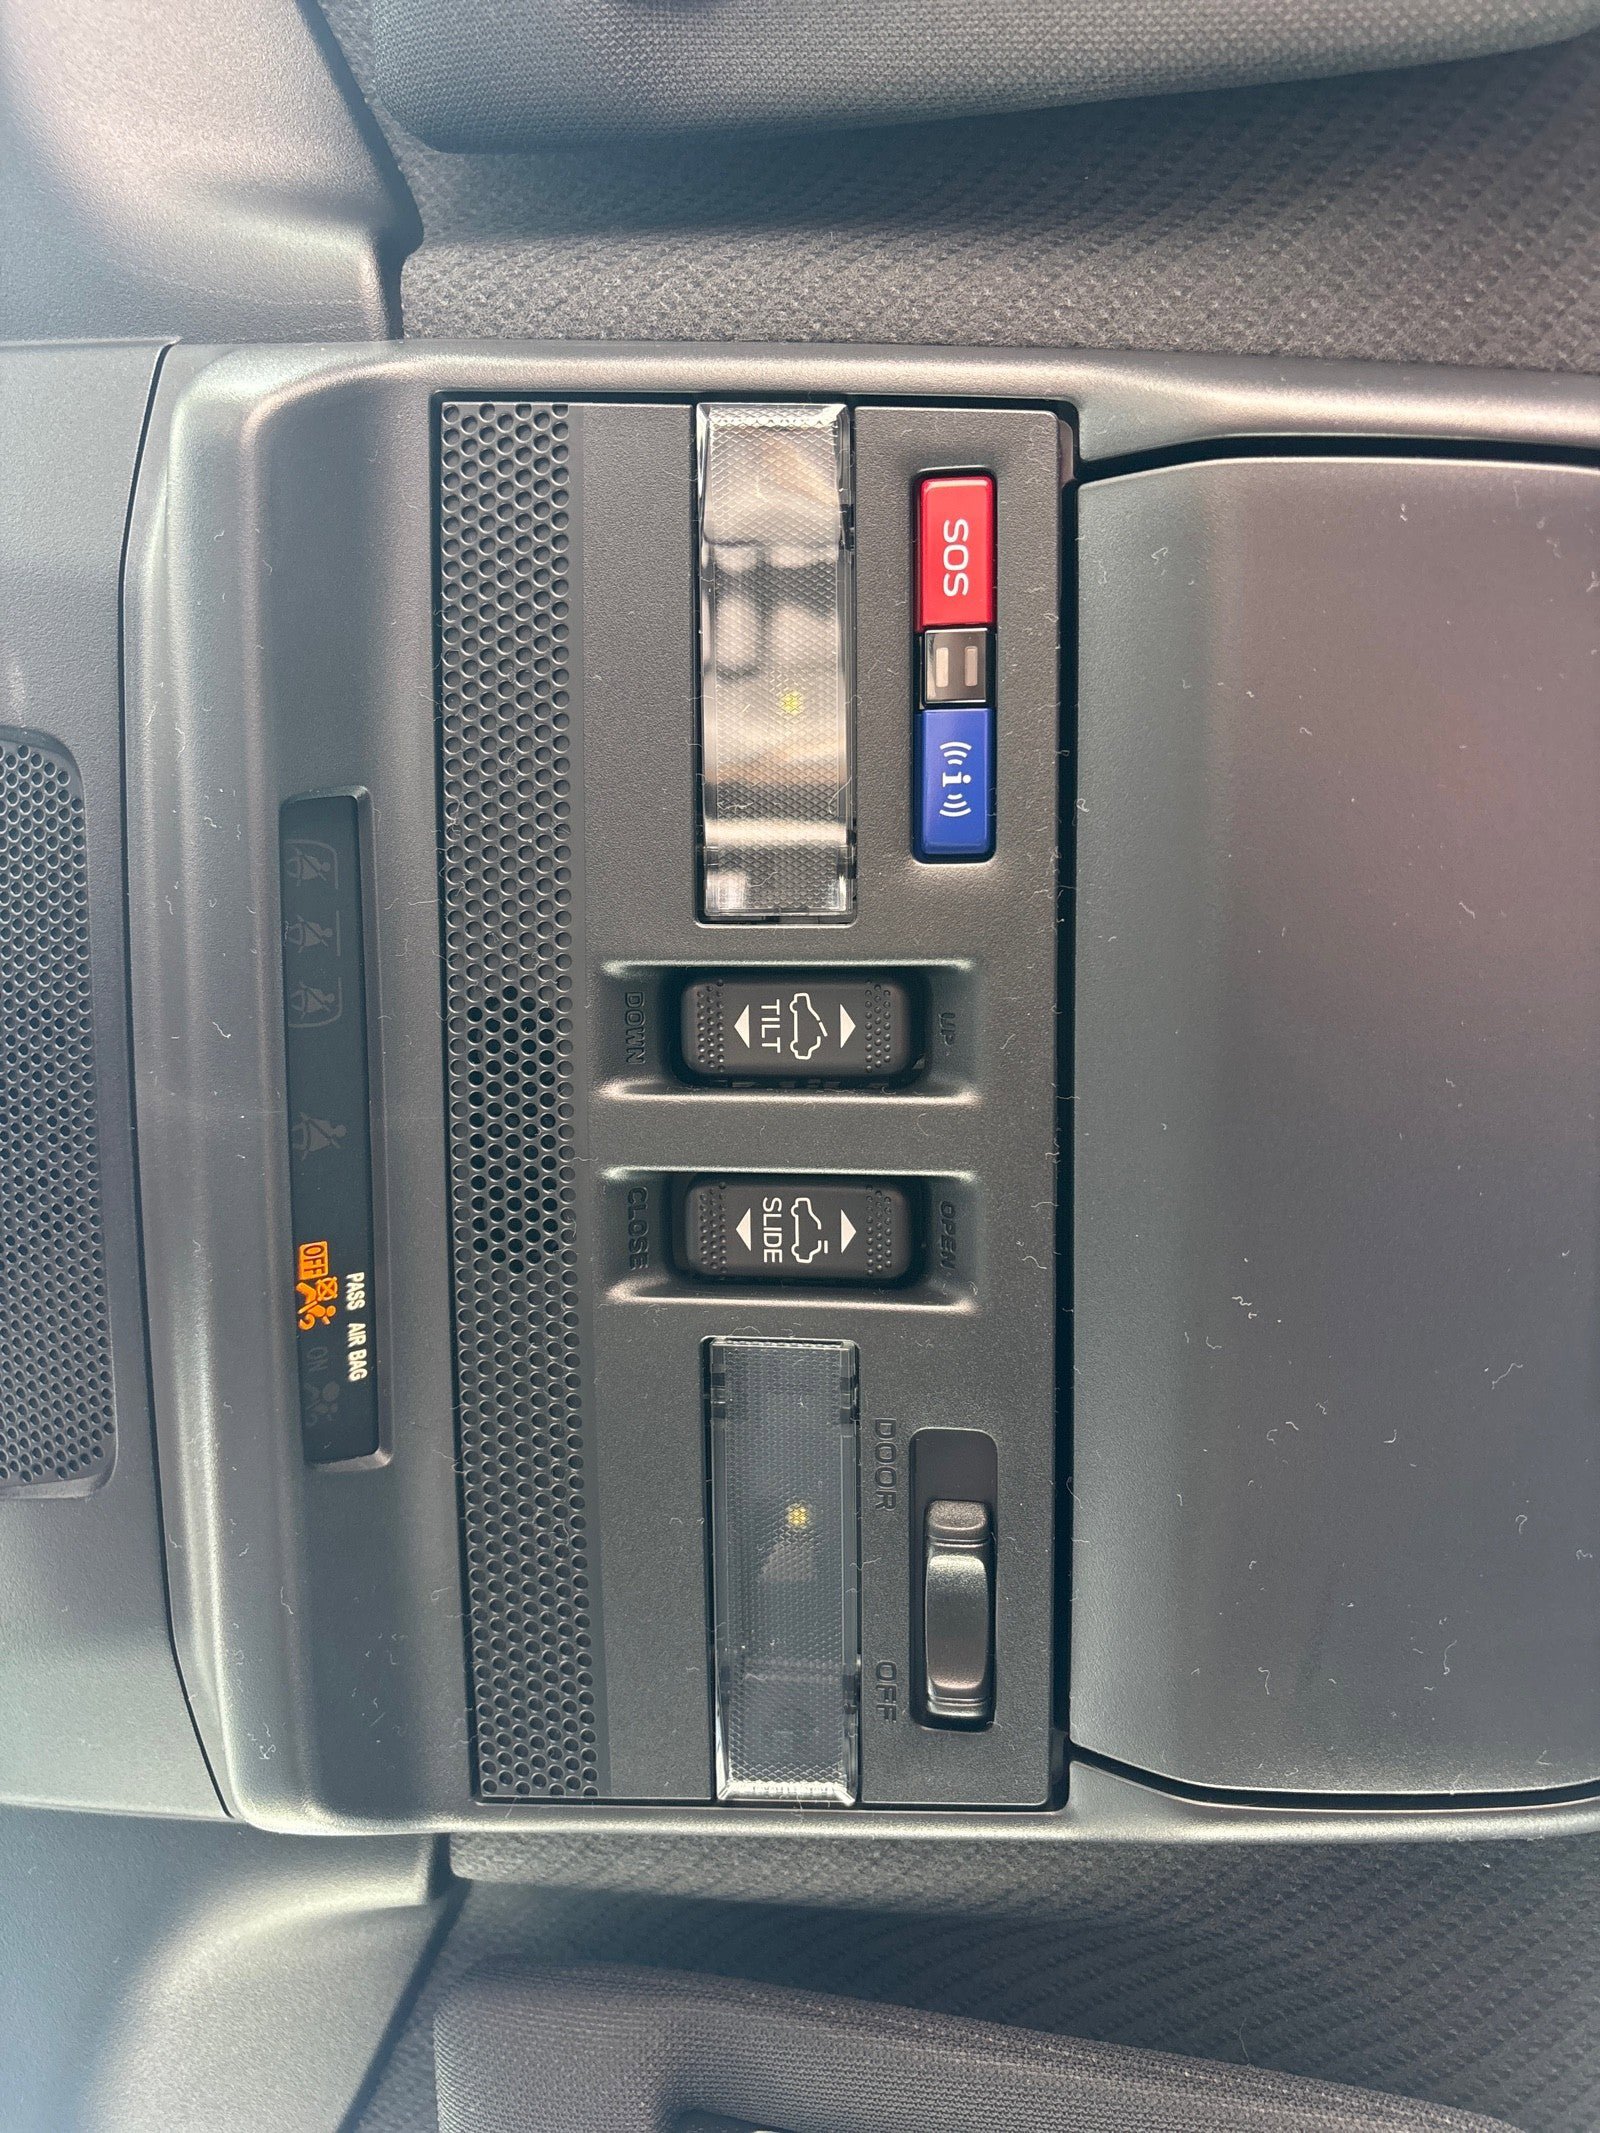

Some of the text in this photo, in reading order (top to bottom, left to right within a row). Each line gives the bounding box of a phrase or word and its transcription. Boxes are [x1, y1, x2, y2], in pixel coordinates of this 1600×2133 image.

[943, 518, 969, 597] SOS
[625, 992, 646, 1065] DOWN
[761, 999, 781, 1053] TILT
[938, 1012, 956, 1046] UP
[303, 1244, 325, 1276] OFF
[627, 1186, 649, 1271] CLOSE
[762, 1197, 783, 1263] SLIDE
[939, 1200, 957, 1270] OPEN
[307, 1346, 328, 1373] ON
[346, 1271, 368, 1382] PASS AIR BAG
[875, 1418, 897, 1511] DOOR
[876, 1660, 898, 1723] OFF
